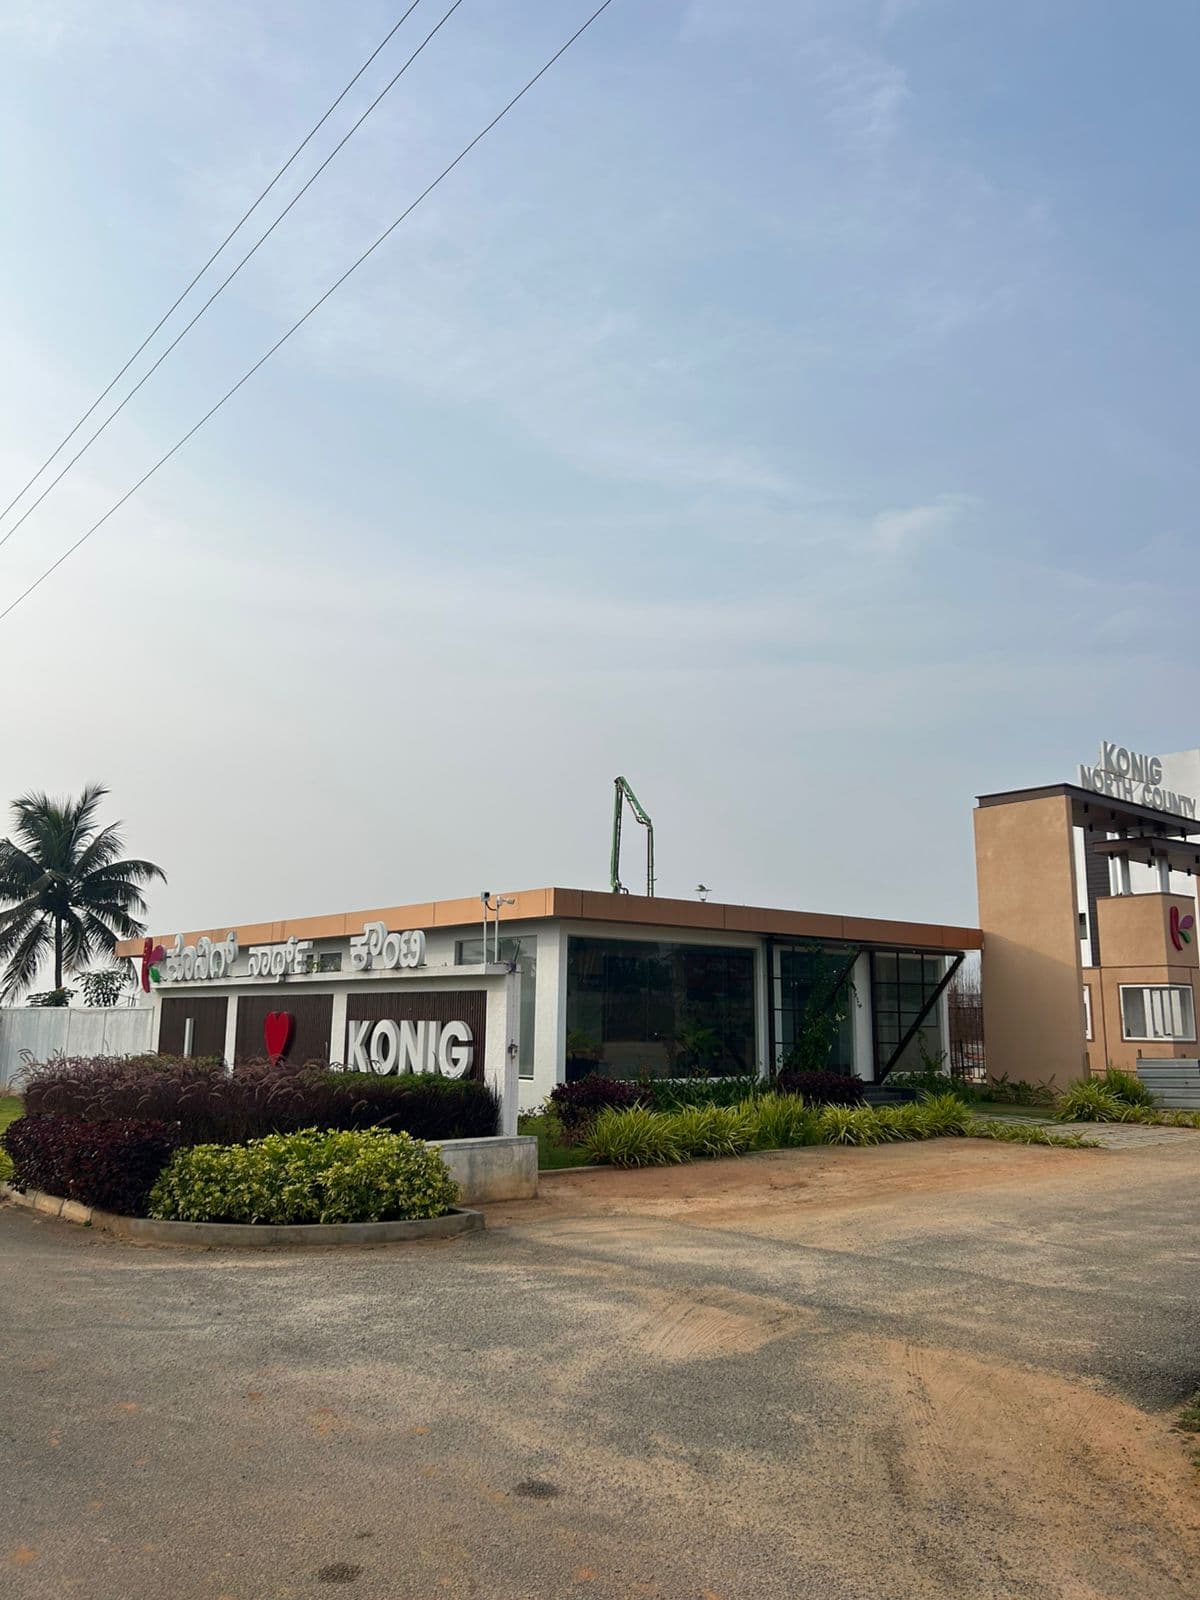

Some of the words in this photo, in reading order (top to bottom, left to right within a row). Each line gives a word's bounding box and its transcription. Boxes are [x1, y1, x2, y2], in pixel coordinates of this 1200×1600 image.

[1100, 740, 1162, 785] KONIG
[1077, 764, 1134, 803] NORTH
[1142, 783, 1197, 820] COUNTY
[348, 1019, 474, 1079] KONIG
